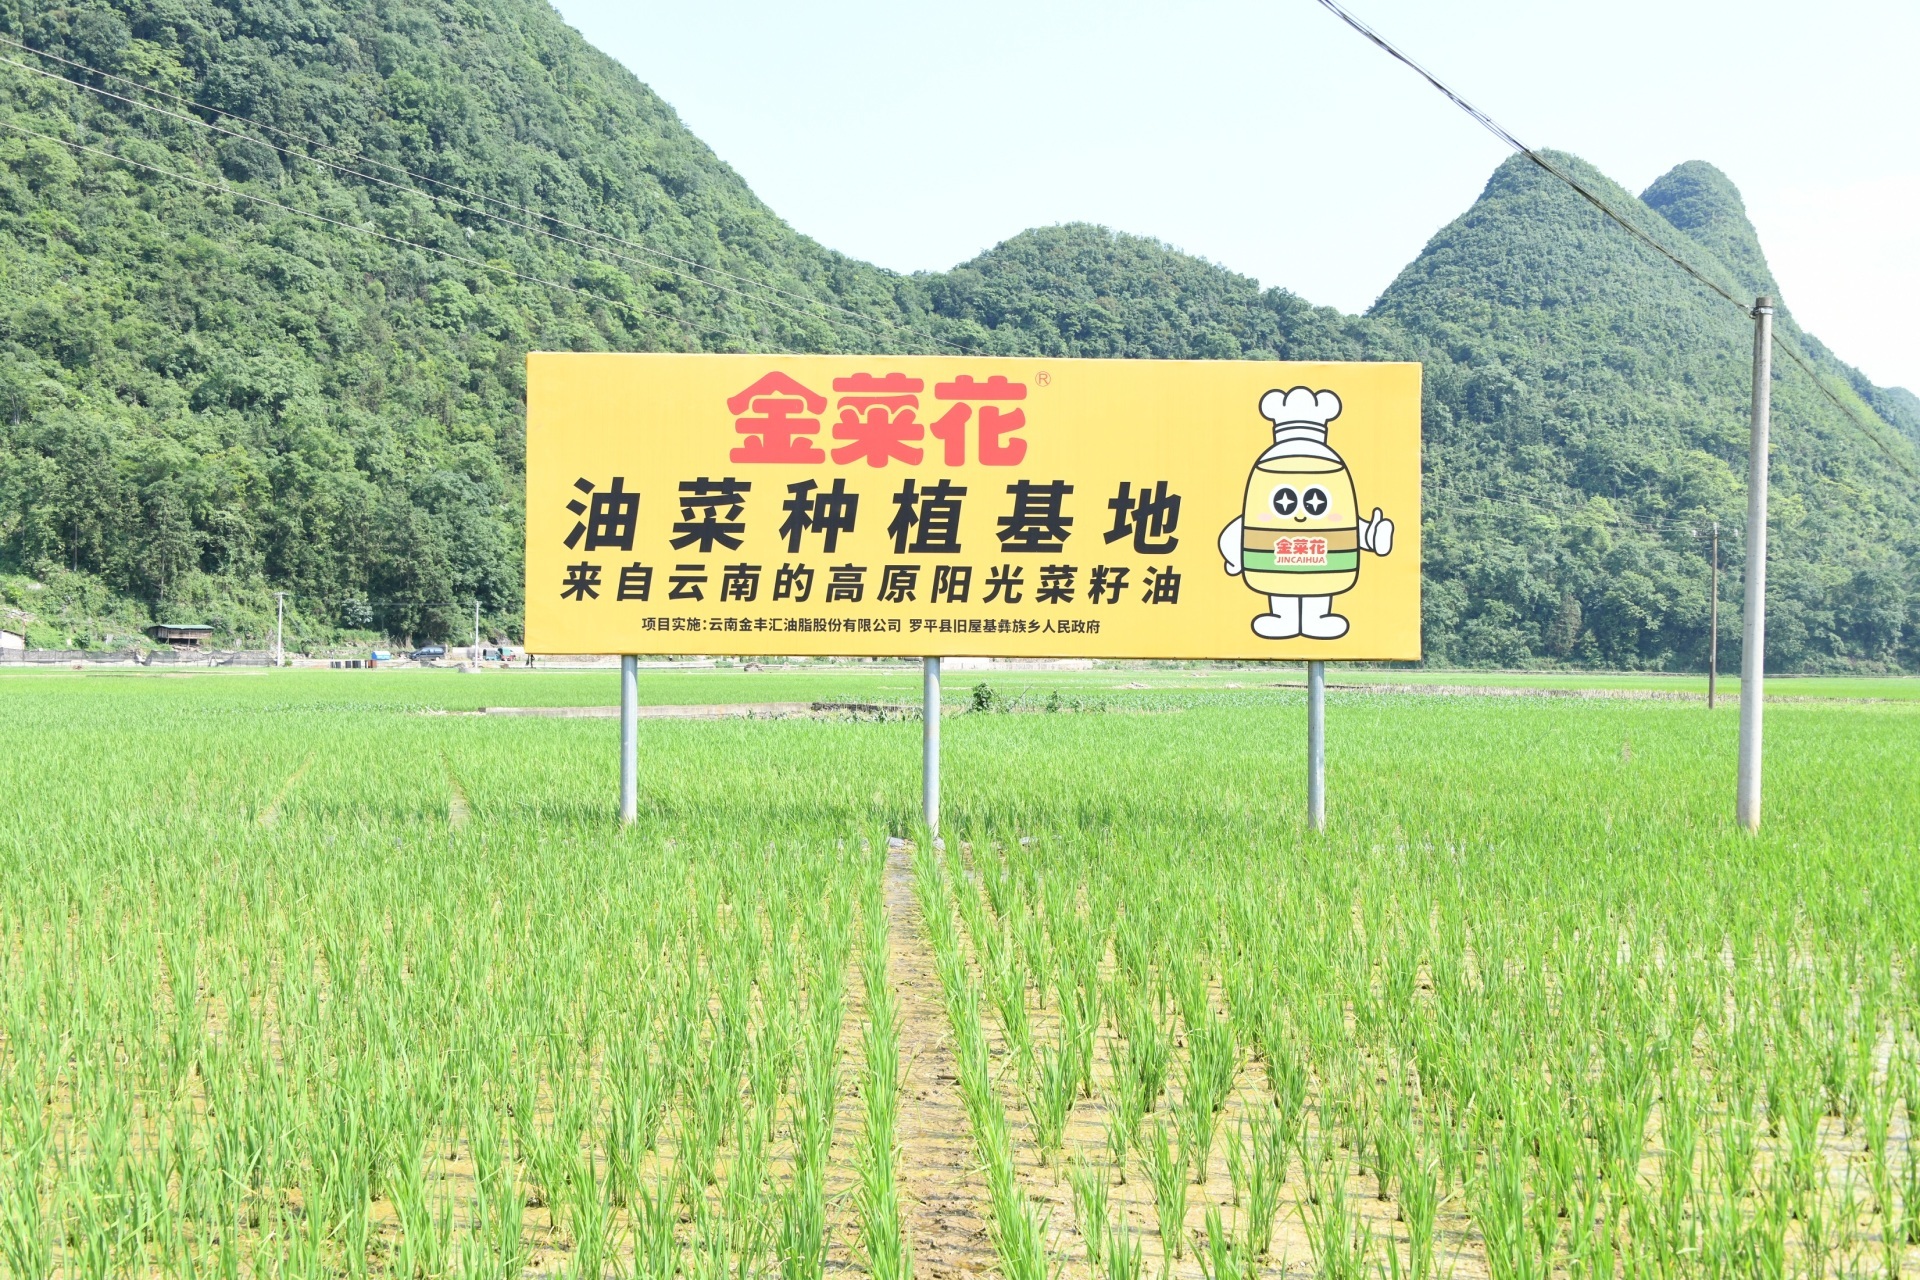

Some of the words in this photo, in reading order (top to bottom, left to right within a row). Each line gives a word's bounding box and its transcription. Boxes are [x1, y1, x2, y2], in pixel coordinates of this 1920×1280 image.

[727, 371, 1028, 468] 金菜花
[563, 477, 1182, 555] 油菜种植基地
[1276, 538, 1326, 555] 金菜花
[1277, 556, 1325, 564] JINCAIHUA
[560, 561, 1182, 605] 来自云南的高原阳光菜籽油
[909, 618, 1101, 634] 罗平县旧屋基彝族乡人民政府
